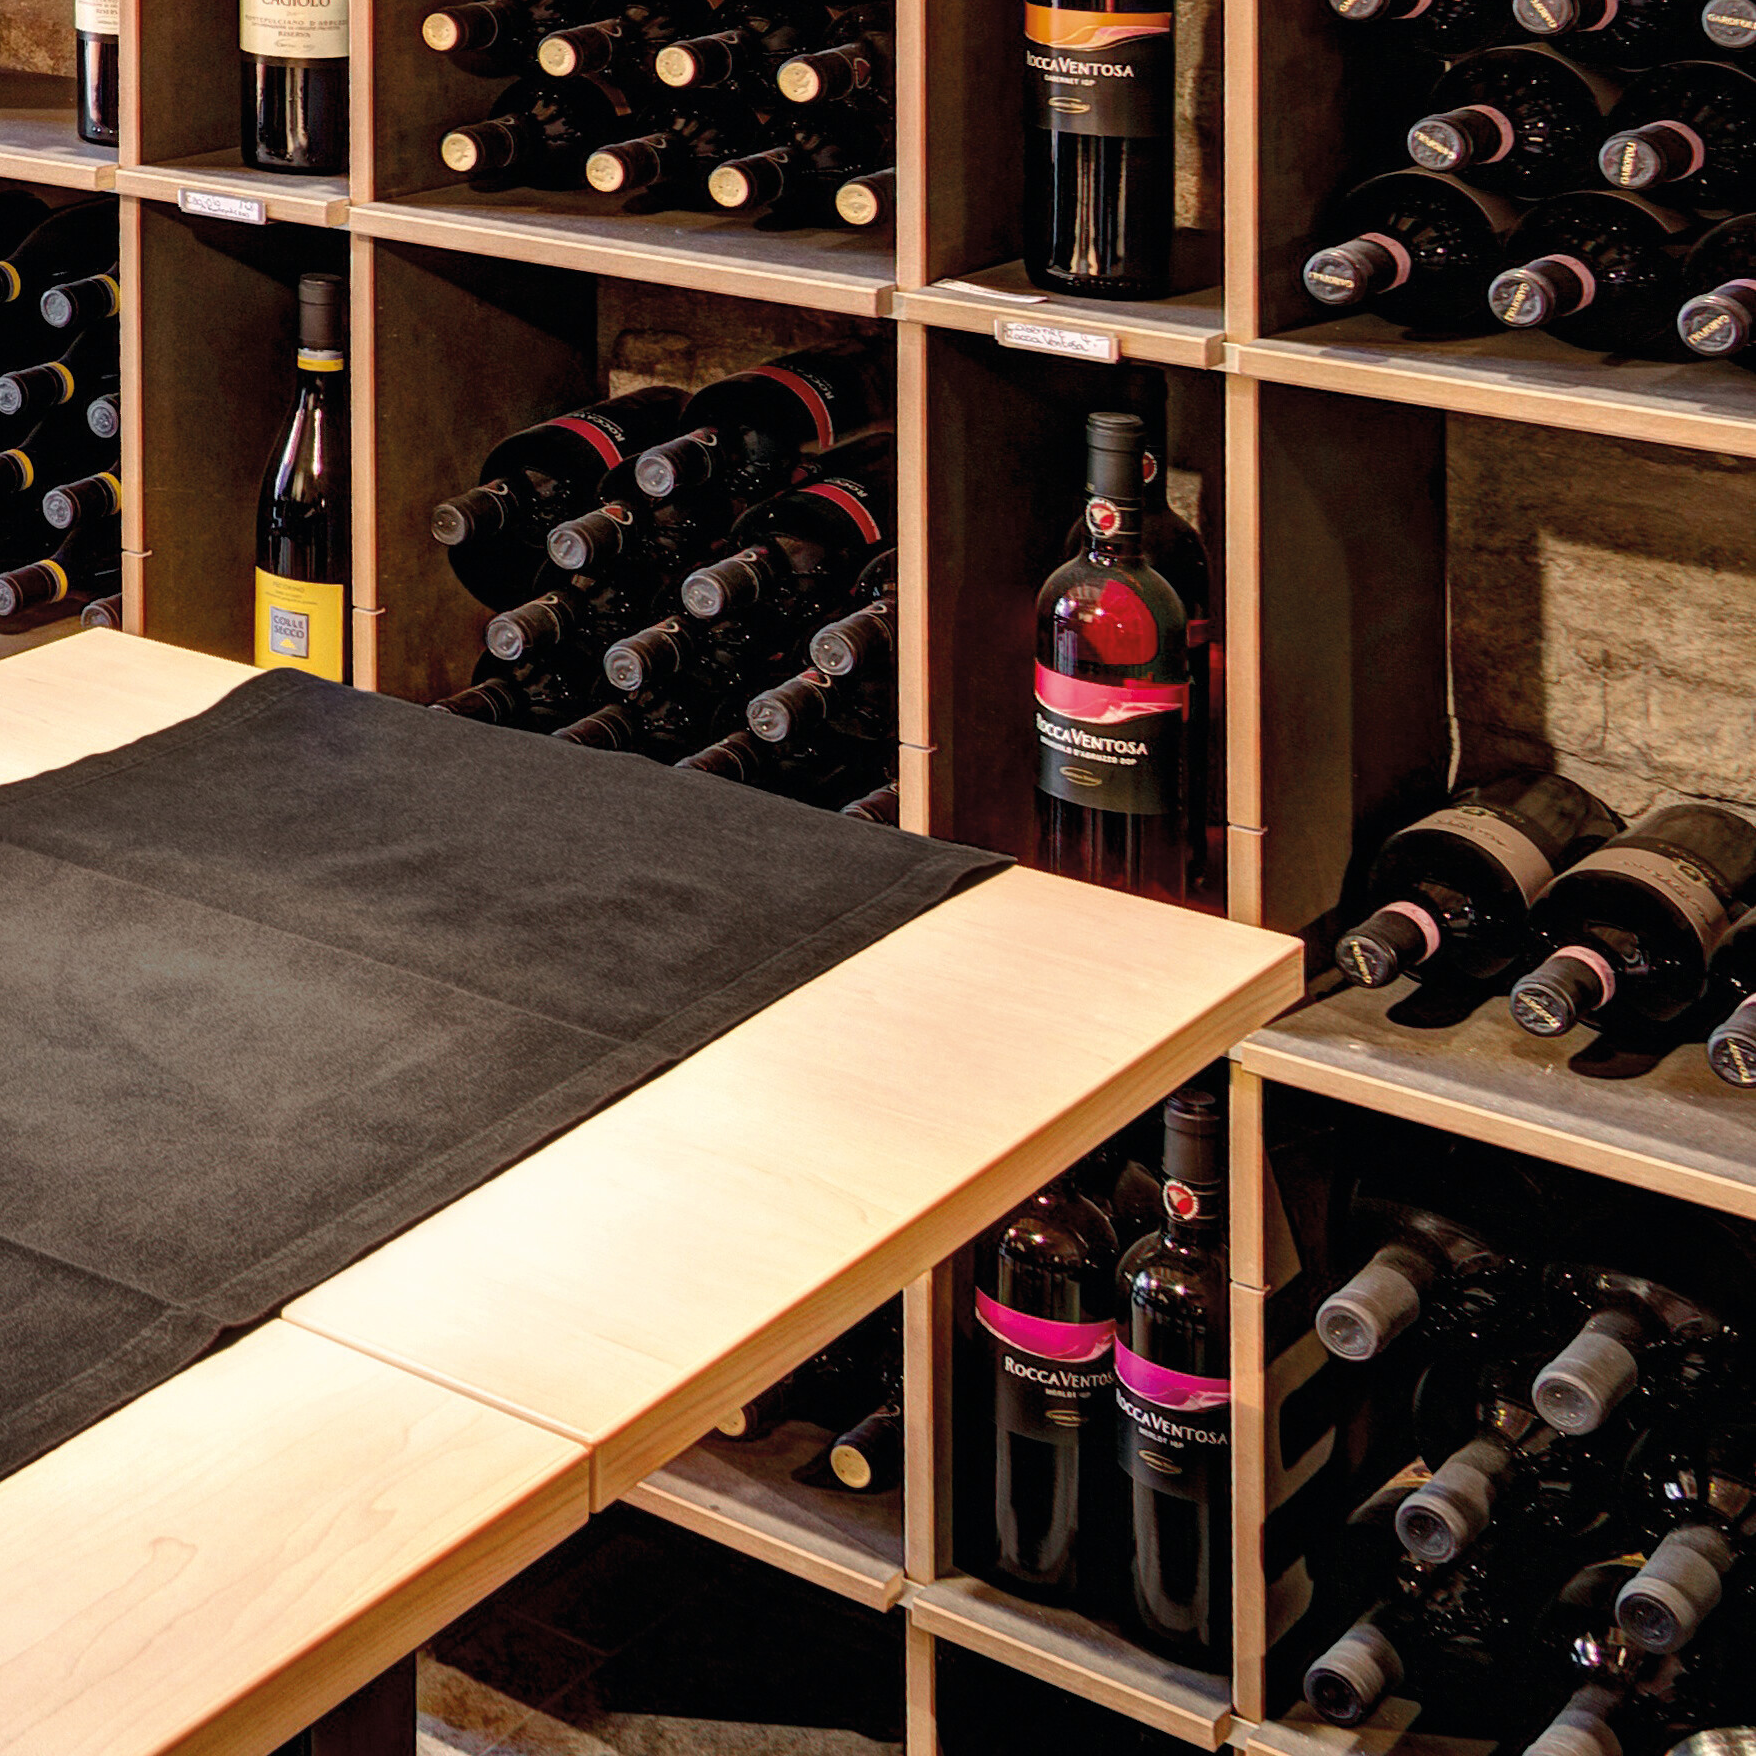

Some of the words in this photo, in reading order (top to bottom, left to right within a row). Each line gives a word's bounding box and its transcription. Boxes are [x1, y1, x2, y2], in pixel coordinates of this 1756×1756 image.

[1706, 13, 1756, 31] GAROFOL
[277, 30, 312, 38] RISERVA
[272, 615, 304, 630] COLLE
[273, 625, 305, 639] SECCO
[1003, 1355, 1115, 1389] ROCCAVENTOS
